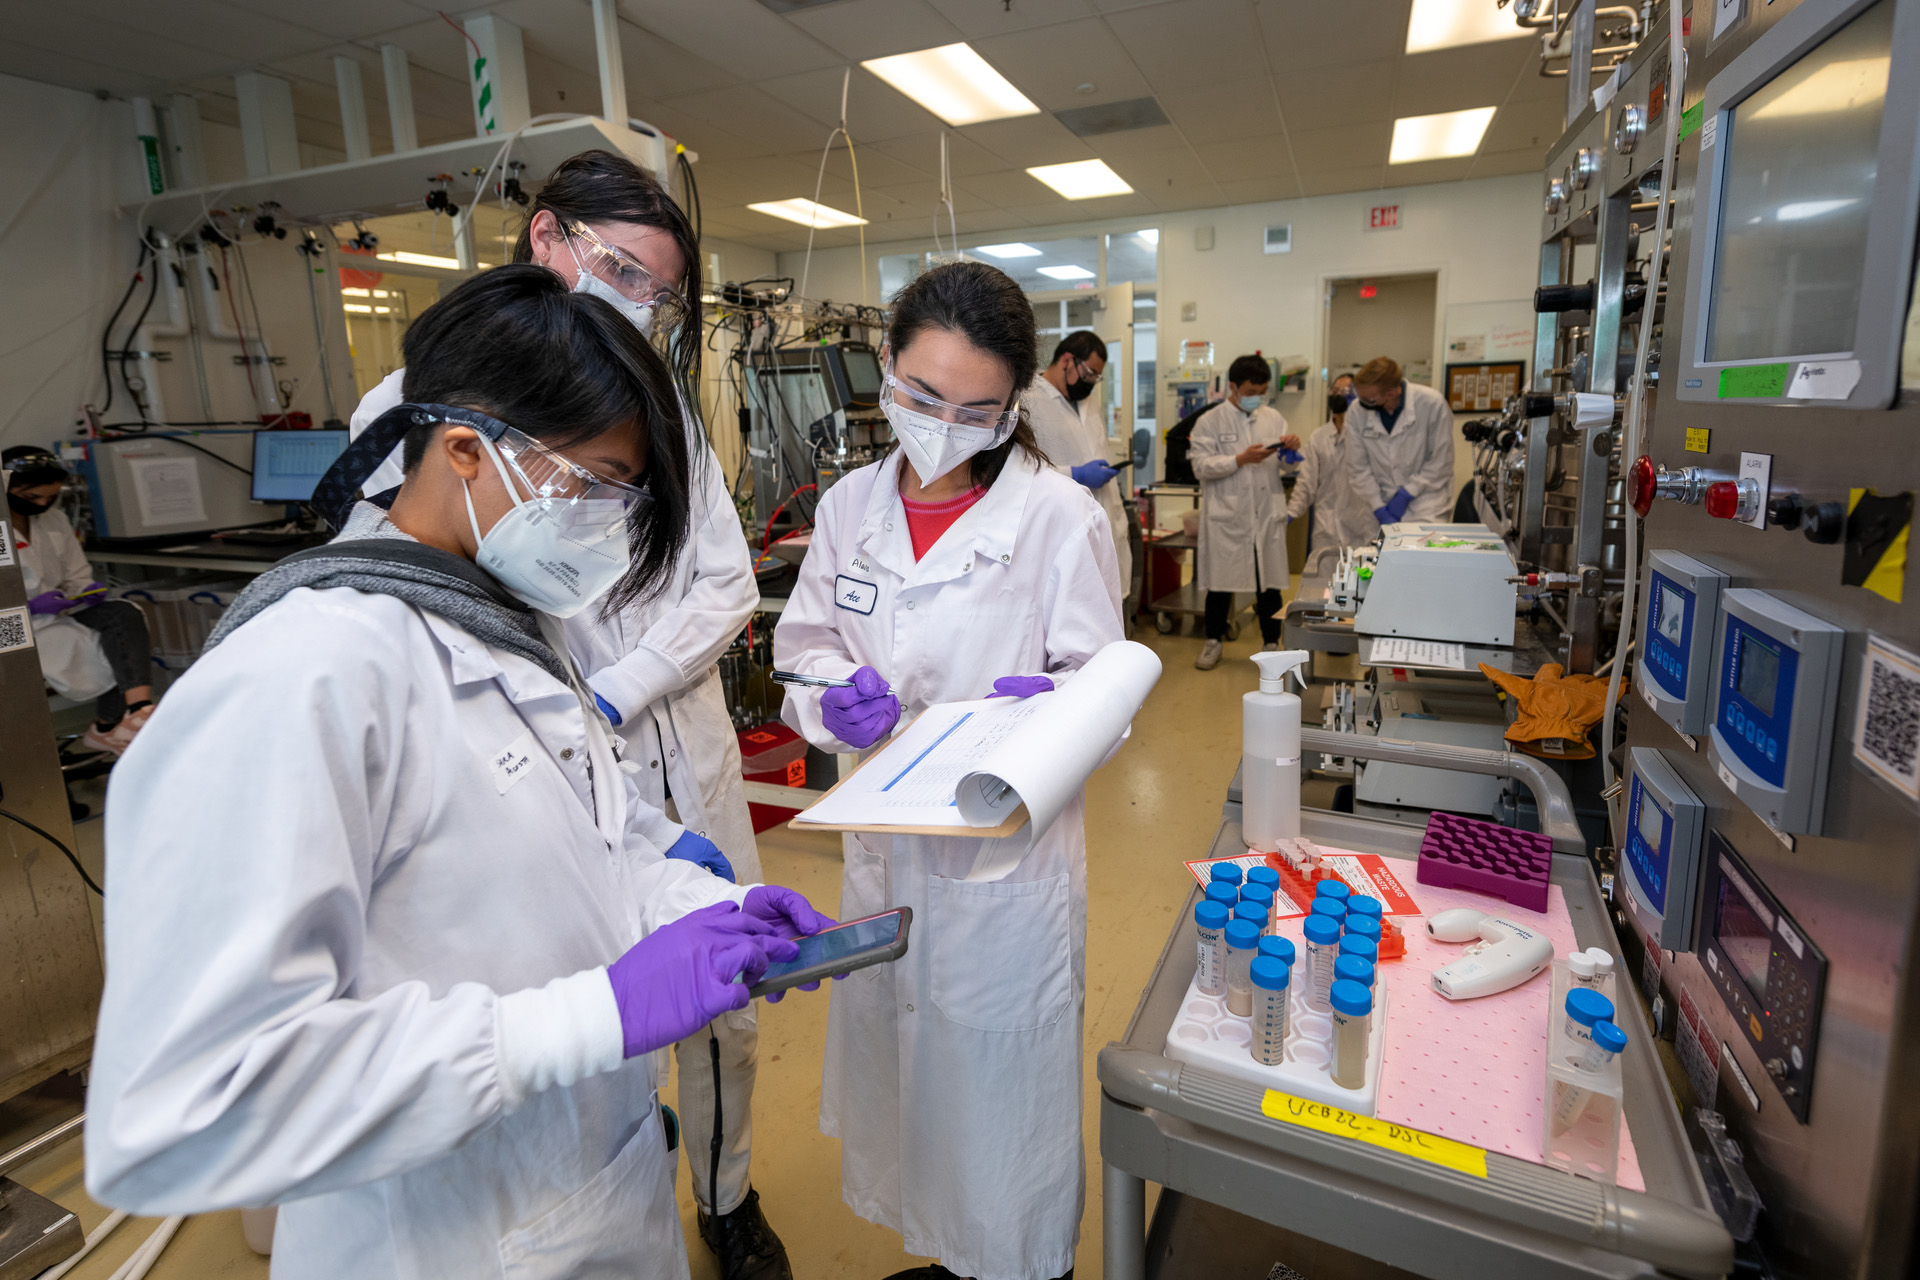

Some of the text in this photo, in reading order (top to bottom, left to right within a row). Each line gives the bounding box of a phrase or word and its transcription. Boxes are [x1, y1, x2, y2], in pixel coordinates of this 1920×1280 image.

[1370, 205, 1399, 228] EXIT
[566, 584, 581, 598] KN95
[1729, 661, 1738, 688] METTLER
[1372, 873, 1391, 891] WASTE
[1376, 866, 1406, 898] HAZARDOUS
[1495, 919, 1533, 938] powerpette
[1516, 932, 1529, 940] Pro
